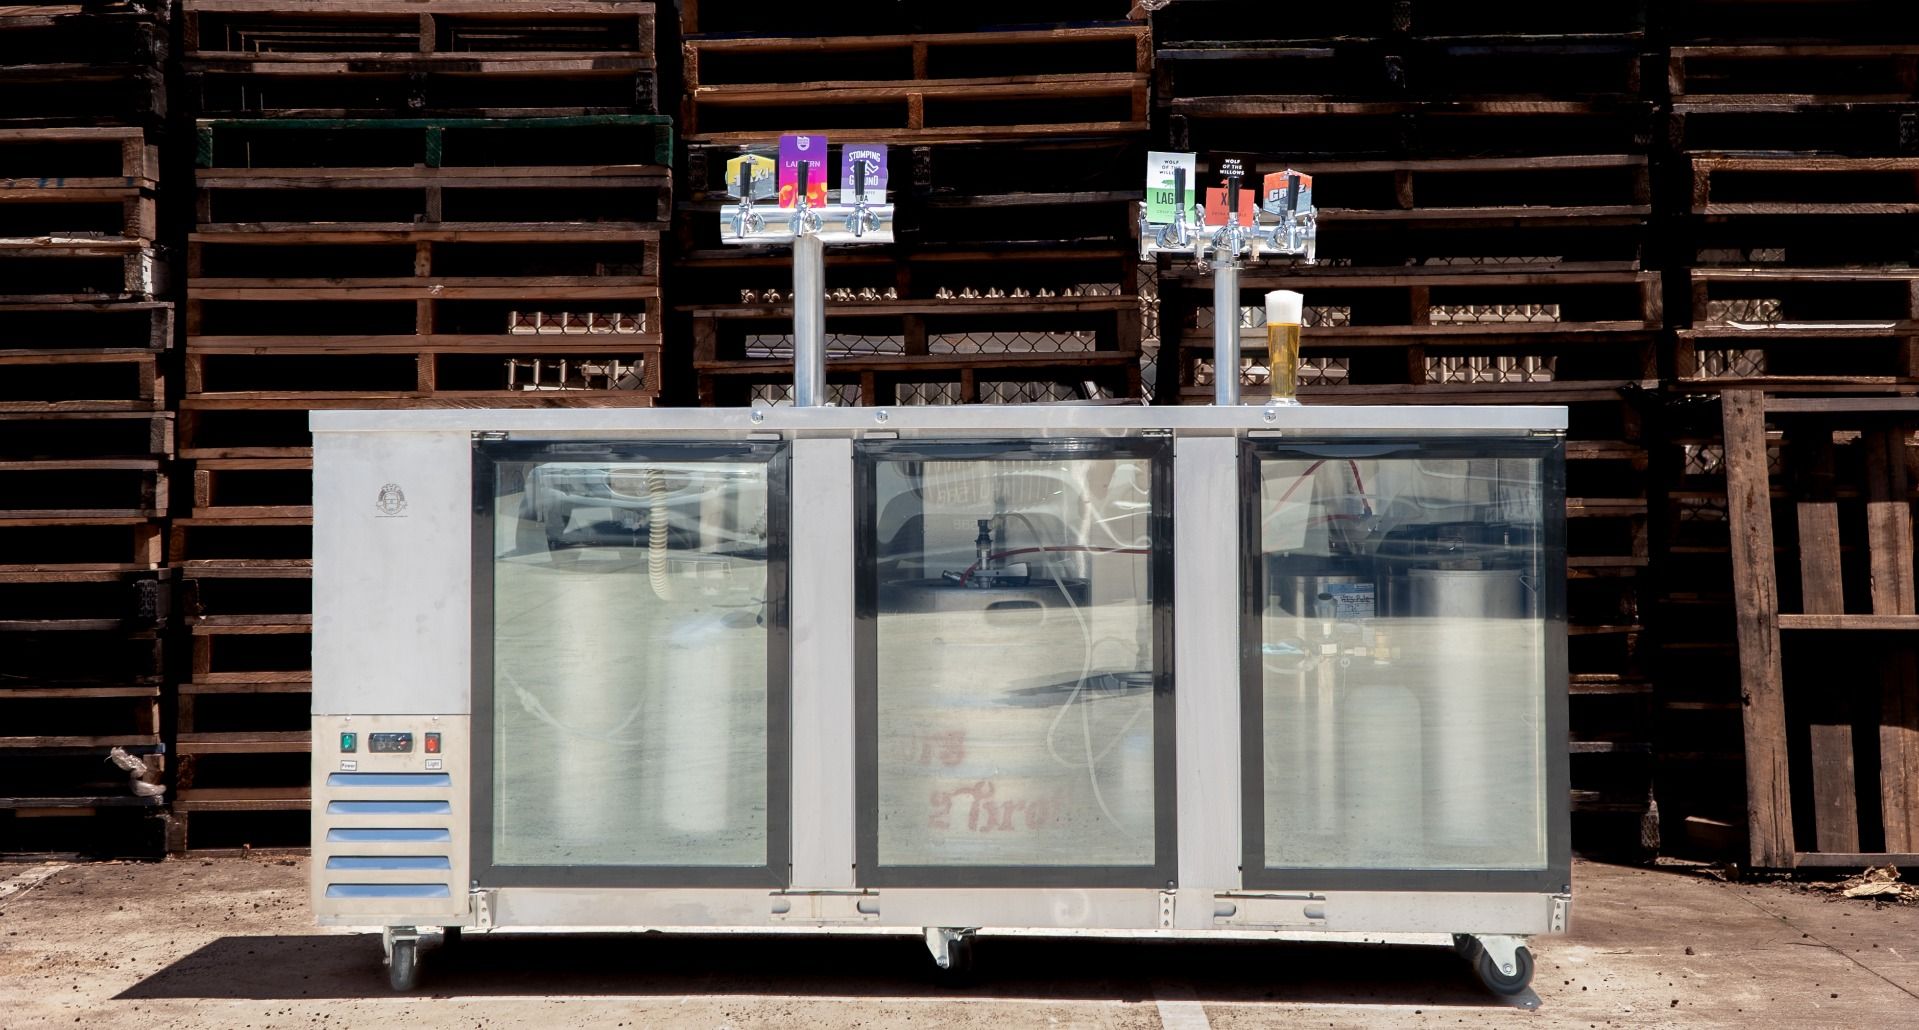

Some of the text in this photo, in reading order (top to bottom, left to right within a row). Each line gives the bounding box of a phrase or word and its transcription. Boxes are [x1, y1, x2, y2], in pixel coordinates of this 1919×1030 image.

[848, 150, 881, 162] STOMPING
[848, 174, 879, 186] GUND
[1156, 191, 1174, 205] LAG
[427, 760, 440, 768] Light
